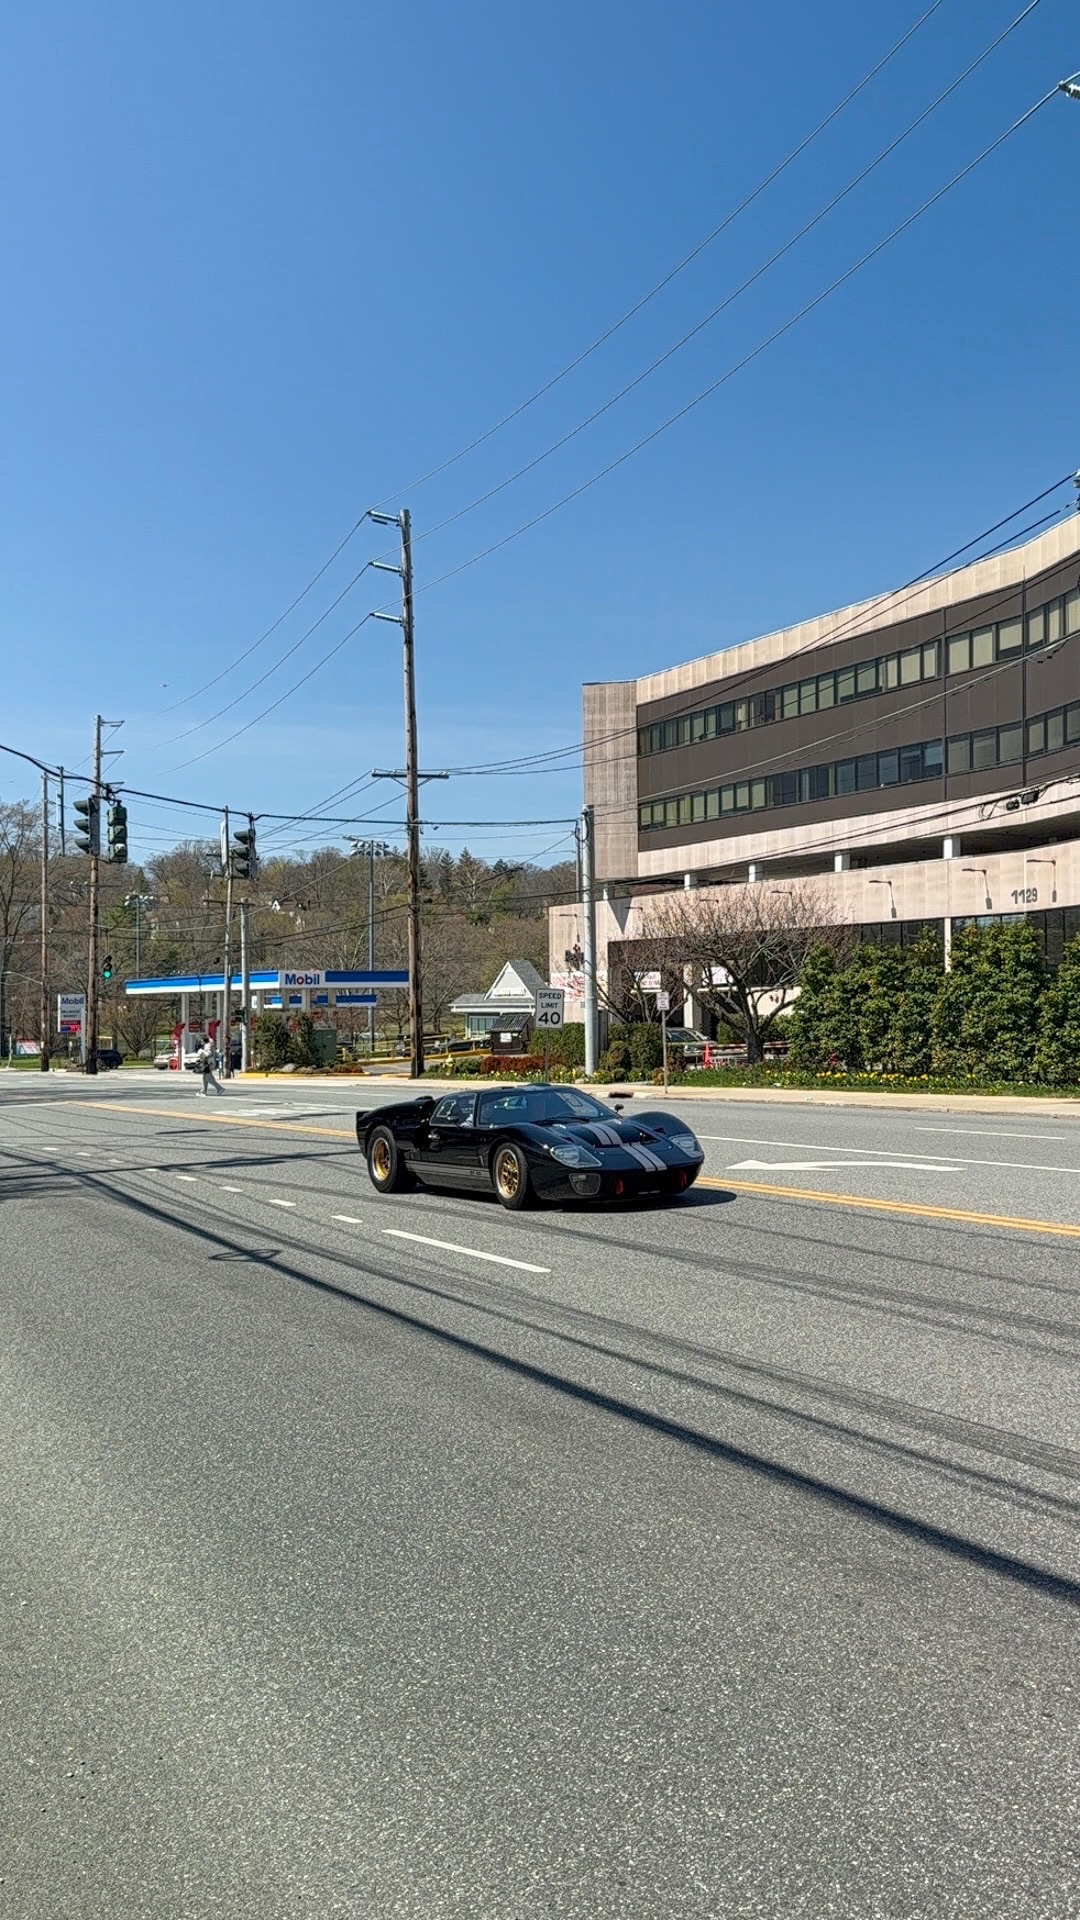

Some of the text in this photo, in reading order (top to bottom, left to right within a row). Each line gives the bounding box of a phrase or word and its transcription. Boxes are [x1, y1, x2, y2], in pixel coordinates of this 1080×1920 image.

[1010, 887, 1038, 905] 1129
[285, 973, 320, 985] Mobil
[61, 997, 84, 1005] Mobil
[538, 992, 562, 1000] SPEED
[538, 1011, 561, 1025] 40
